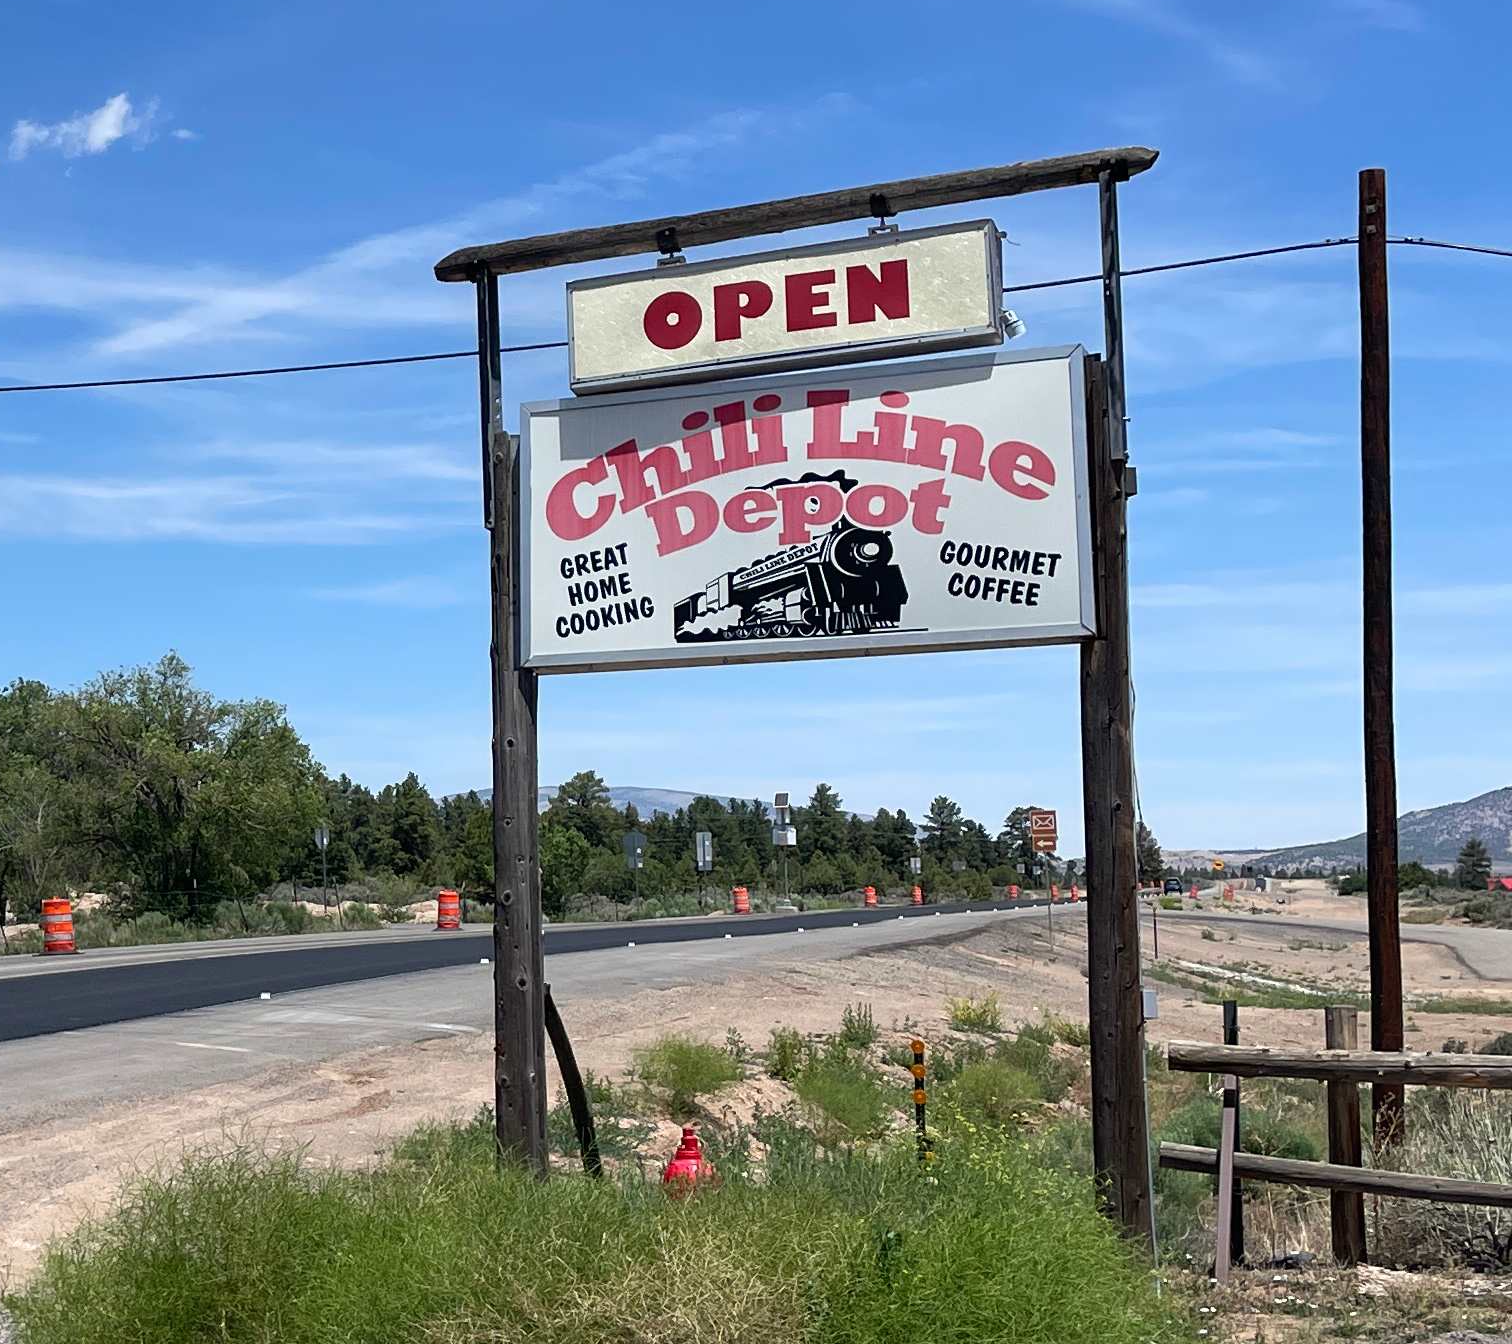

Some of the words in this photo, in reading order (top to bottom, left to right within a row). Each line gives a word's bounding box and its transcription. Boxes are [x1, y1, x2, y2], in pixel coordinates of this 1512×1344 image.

[643, 259, 911, 350] OPEN
[546, 394, 788, 541] Chili
[807, 389, 1056, 501] Line
[645, 479, 951, 557] Depot
[560, 542, 628, 579] GREAT
[739, 567, 764, 580] CHILI
[764, 557, 787, 570] LINE
[787, 543, 819, 561] DEPOT
[940, 540, 1062, 577] GOURMET
[568, 572, 632, 606] HOME
[948, 572, 1040, 606] COFFEE
[556, 596, 654, 638] COOKING
